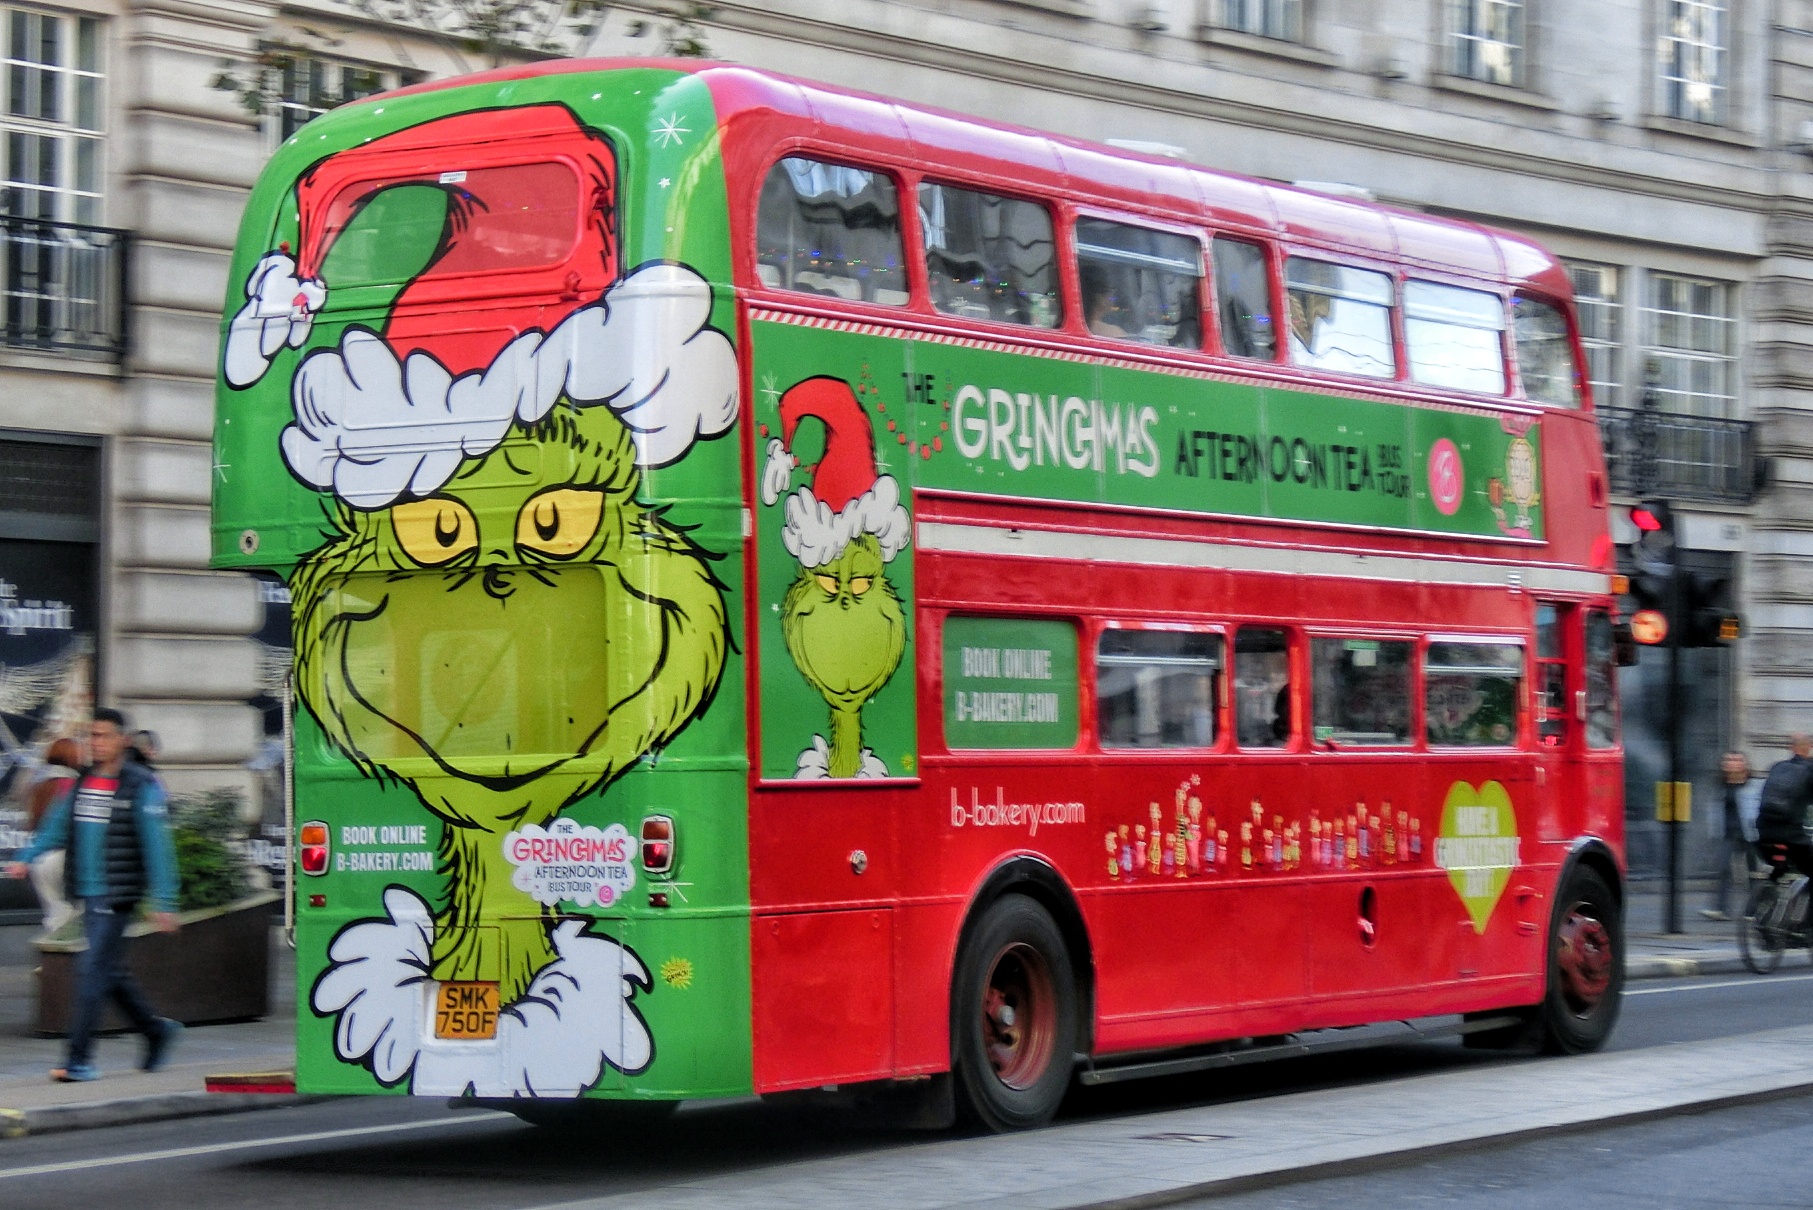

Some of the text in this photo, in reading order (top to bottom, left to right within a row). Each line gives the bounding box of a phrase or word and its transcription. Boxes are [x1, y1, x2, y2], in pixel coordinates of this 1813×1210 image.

[902, 372, 935, 405] THE
[953, 384, 1159, 478] GRINCHMAS
[1174, 429, 1328, 489] AFTERNOON
[1329, 444, 1376, 492] TEA
[1376, 470, 1412, 499] TOUR
[961, 647, 1052, 680] BOOK ONLINE
[950, 786, 1086, 837] b-bakery.com
[341, 825, 427, 846] BOOK ONLINE
[556, 824, 574, 835] THE
[336, 852, 434, 872] B-BAKERY.COM
[513, 838, 627, 864] GRINCHMAS
[534, 865, 628, 880] AFTERNOON TEA
[548, 881, 593, 893] BUS TOUR
[445, 987, 490, 1010] SMK
[437, 1011, 496, 1034] 750F
